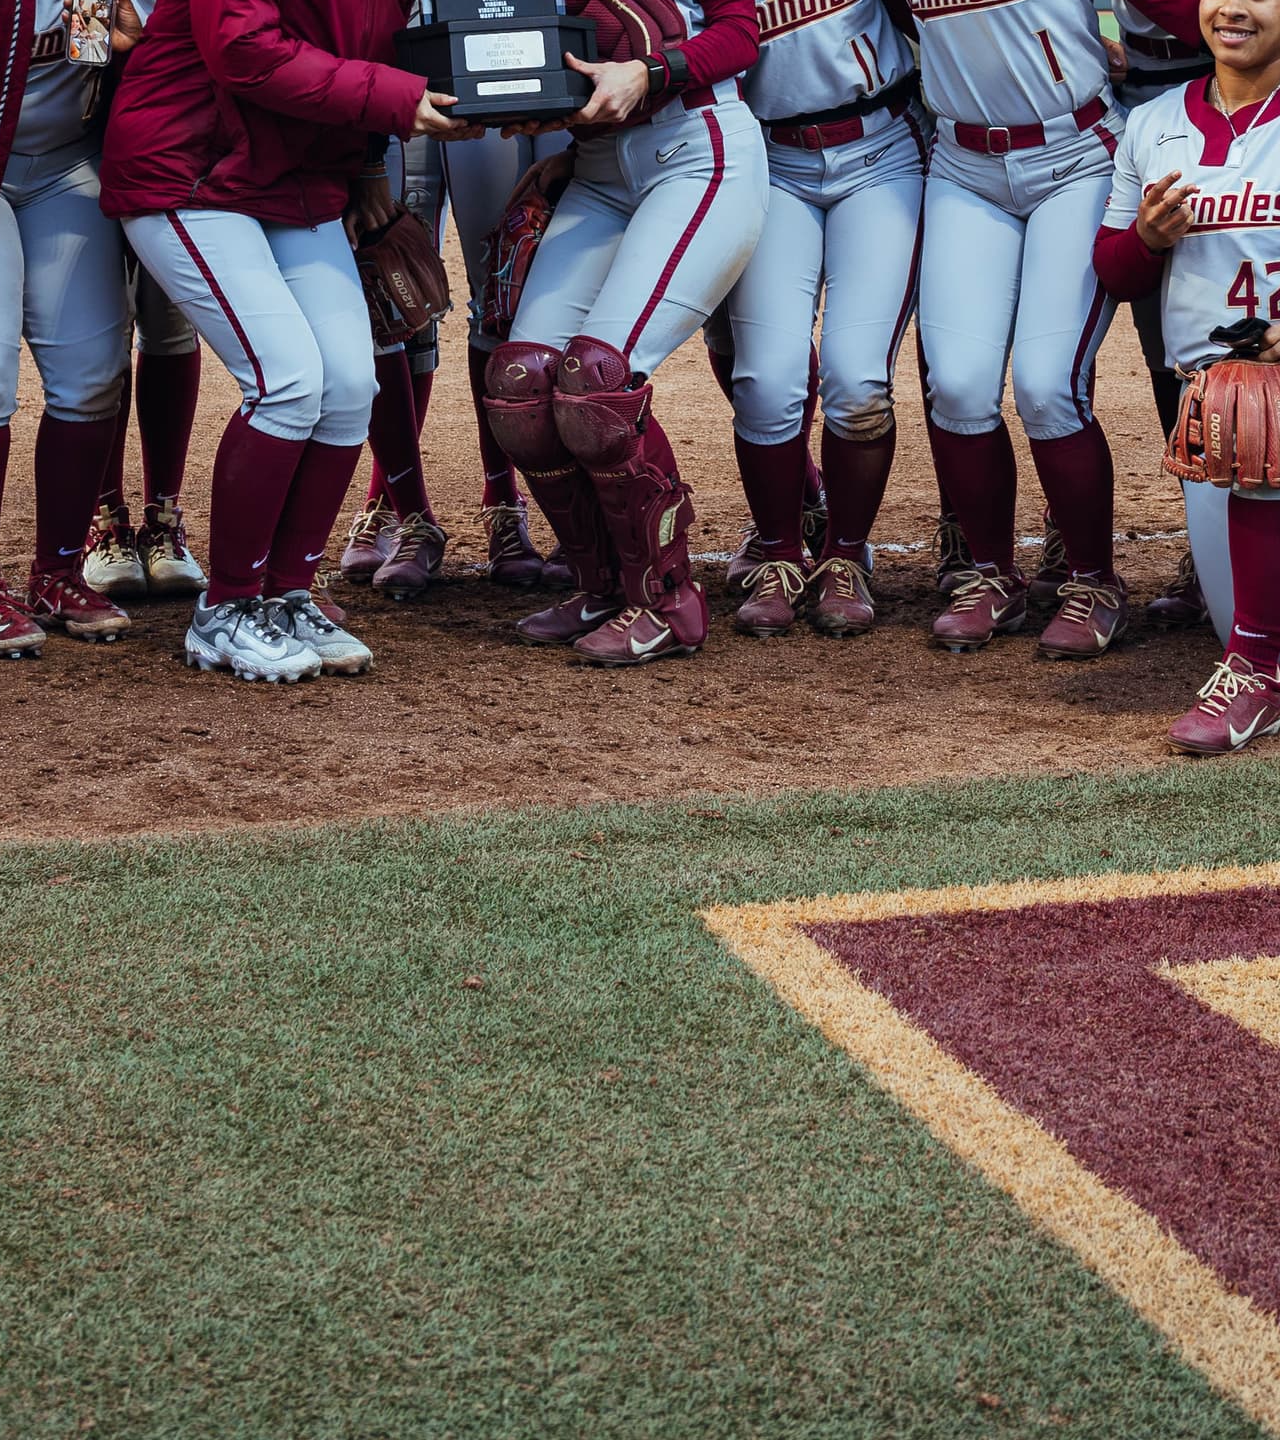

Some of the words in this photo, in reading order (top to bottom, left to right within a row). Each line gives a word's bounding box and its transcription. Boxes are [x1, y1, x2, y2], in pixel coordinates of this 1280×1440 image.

[848, 32, 886, 96] 11
[1033, 28, 1066, 84] 1
[1210, 413, 1222, 460] A2000
